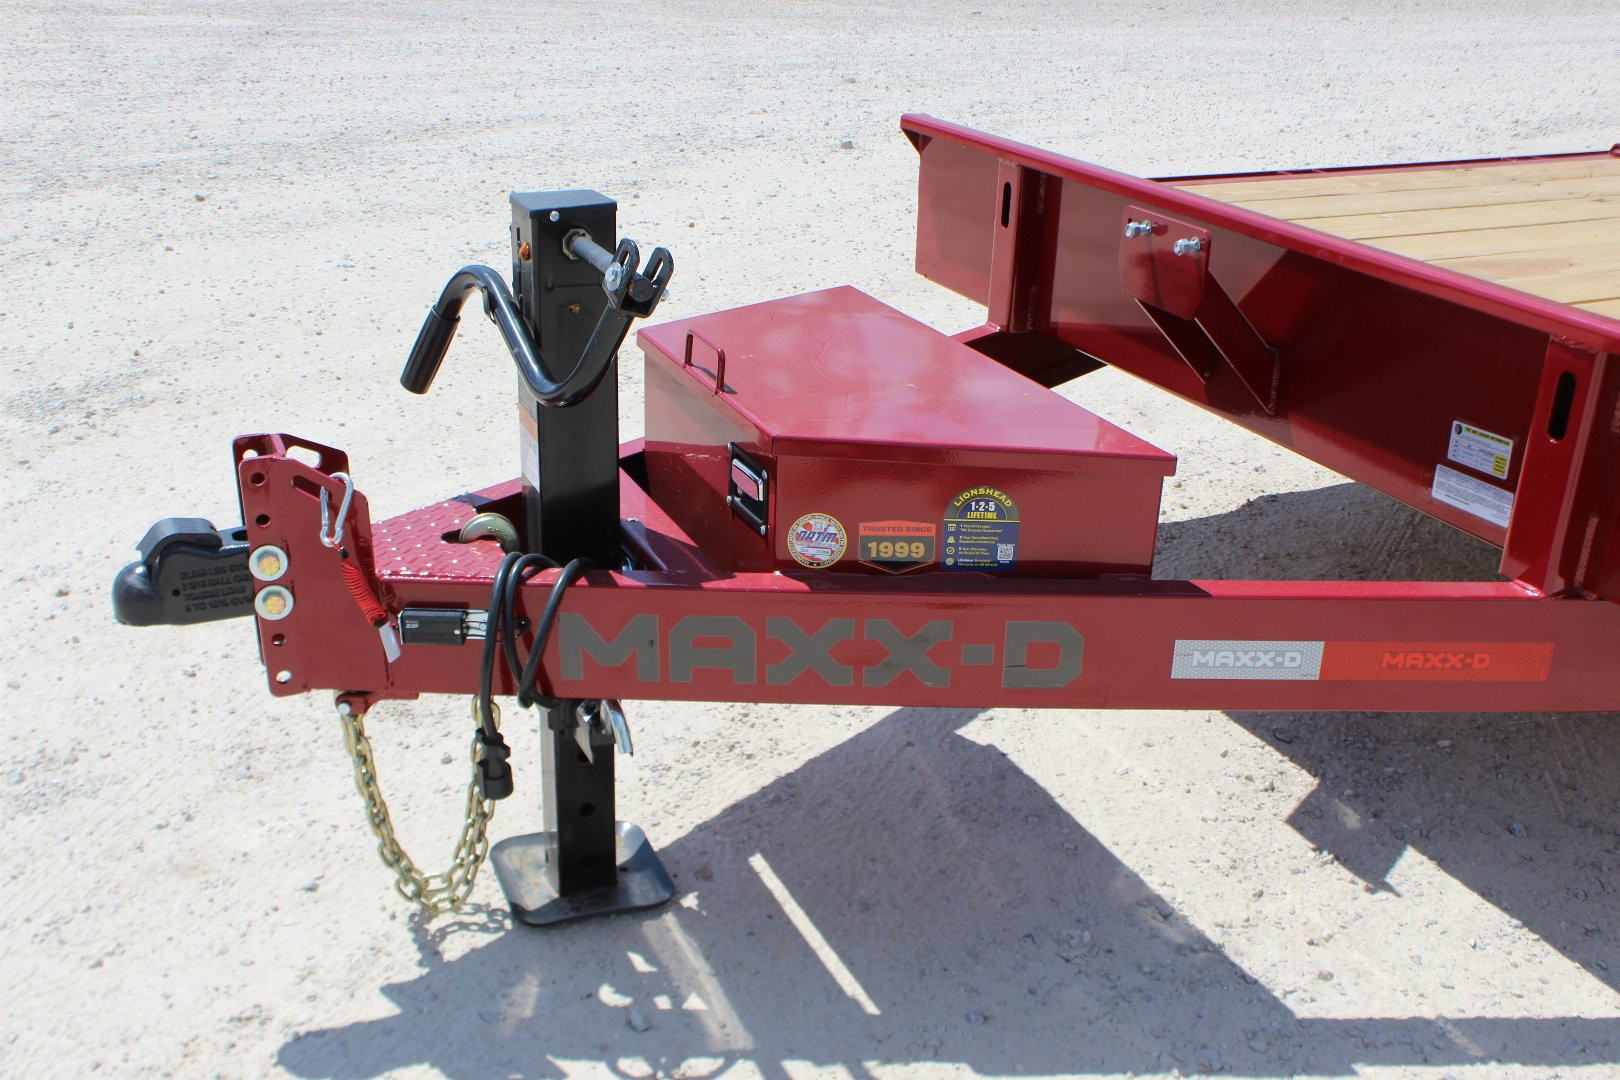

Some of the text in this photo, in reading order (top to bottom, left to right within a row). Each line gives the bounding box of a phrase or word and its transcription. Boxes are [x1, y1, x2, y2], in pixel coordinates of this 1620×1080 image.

[954, 488, 1012, 507] LIONSHEAD
[868, 541, 925, 558] 1999
[558, 612, 1084, 688] MAXX-D
[1192, 650, 1302, 667] MAXX-D
[1382, 652, 1491, 669] MAXX-D
